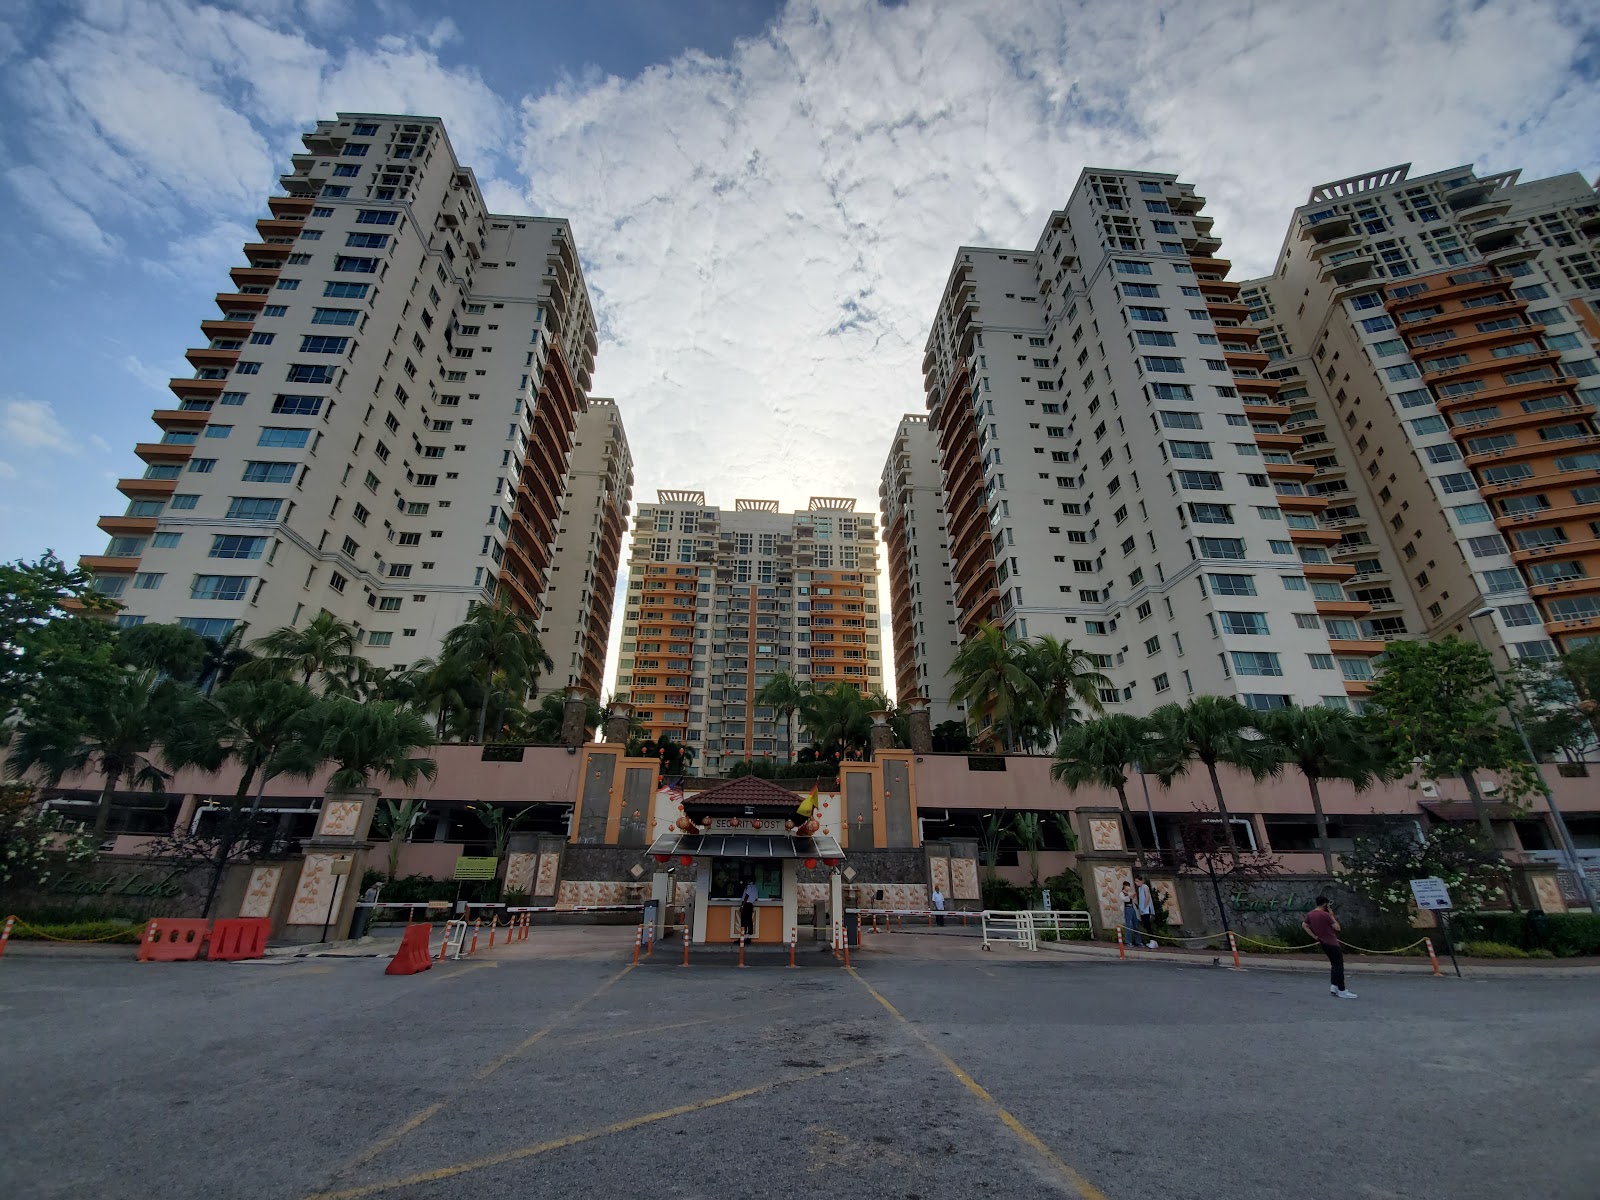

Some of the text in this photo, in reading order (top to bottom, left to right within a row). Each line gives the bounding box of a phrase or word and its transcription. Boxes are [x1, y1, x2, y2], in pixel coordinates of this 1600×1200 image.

[51, 867, 187, 898] East Lake
[1232, 891, 1279, 911] East
